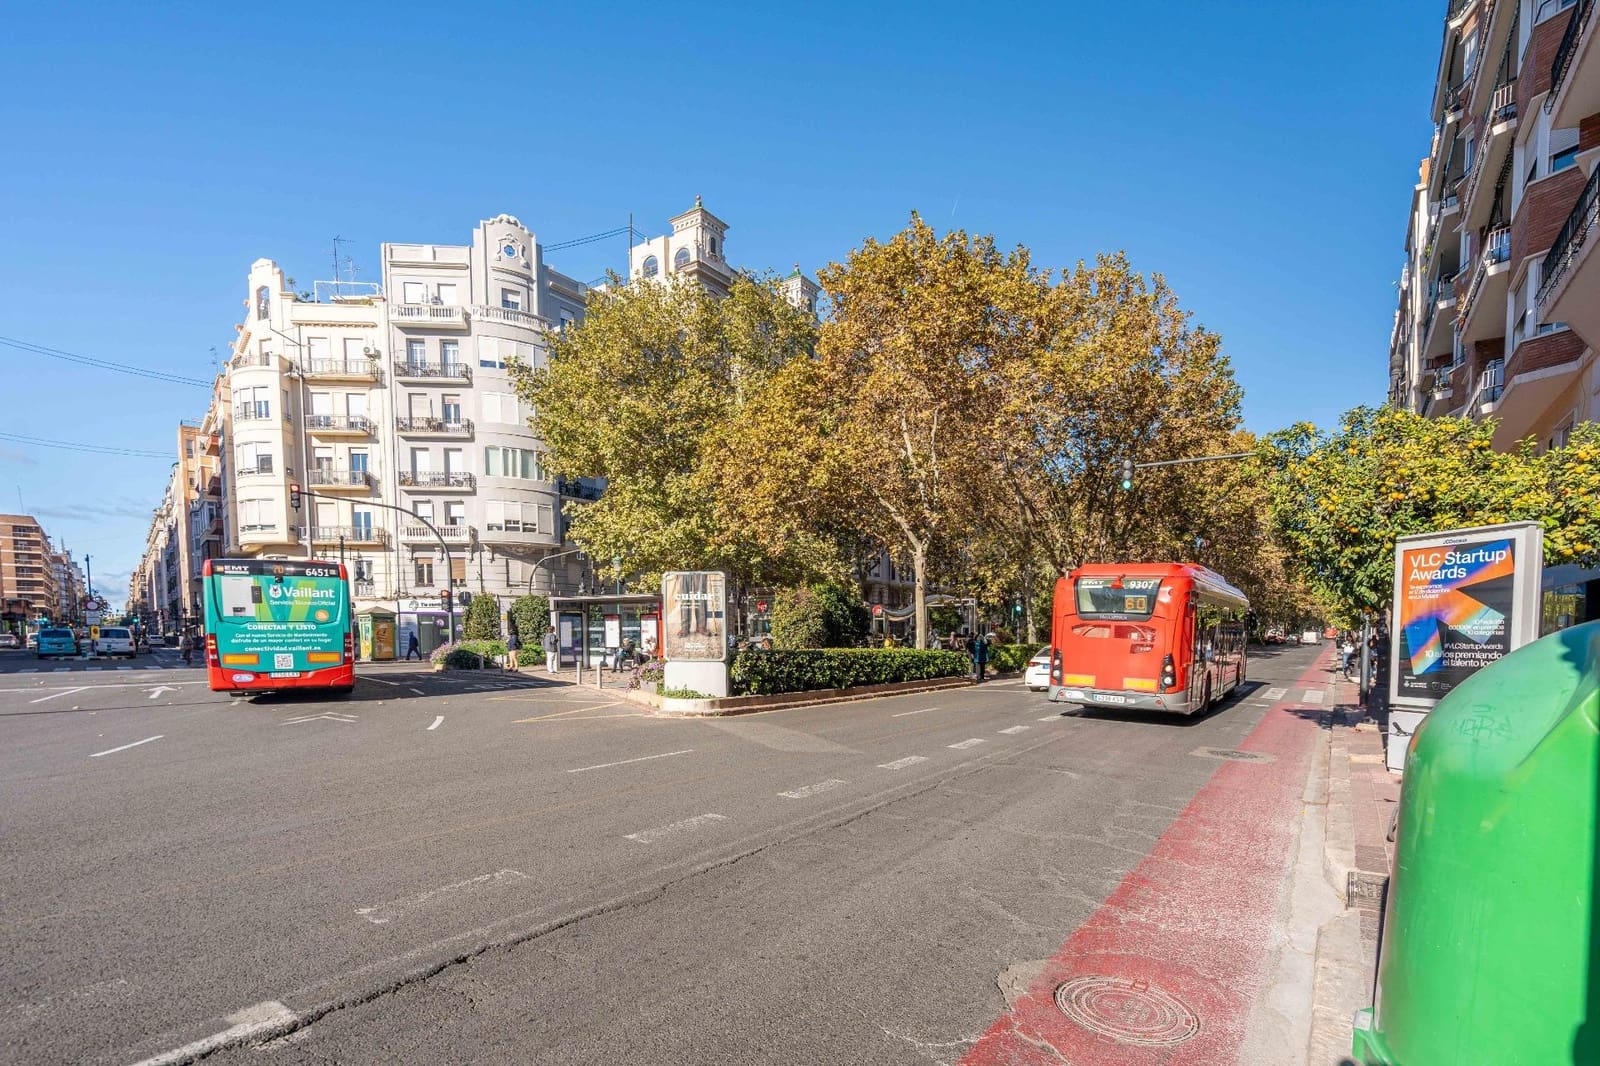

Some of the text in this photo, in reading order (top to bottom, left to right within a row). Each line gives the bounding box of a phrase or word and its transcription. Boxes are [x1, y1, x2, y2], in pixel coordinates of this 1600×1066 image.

[1410, 549, 1506, 568] VLC Startup
[305, 568, 329, 576] 6451
[1409, 566, 1467, 581] Awards
[1129, 581, 1154, 589] 9307
[283, 586, 335, 598] Vaillant
[675, 592, 713, 600] cuidar
[1125, 597, 1146, 610] 60
[1434, 650, 1455, 659] años
[1455, 650, 1503, 660] premiando
[1450, 659, 1479, 667] talento
